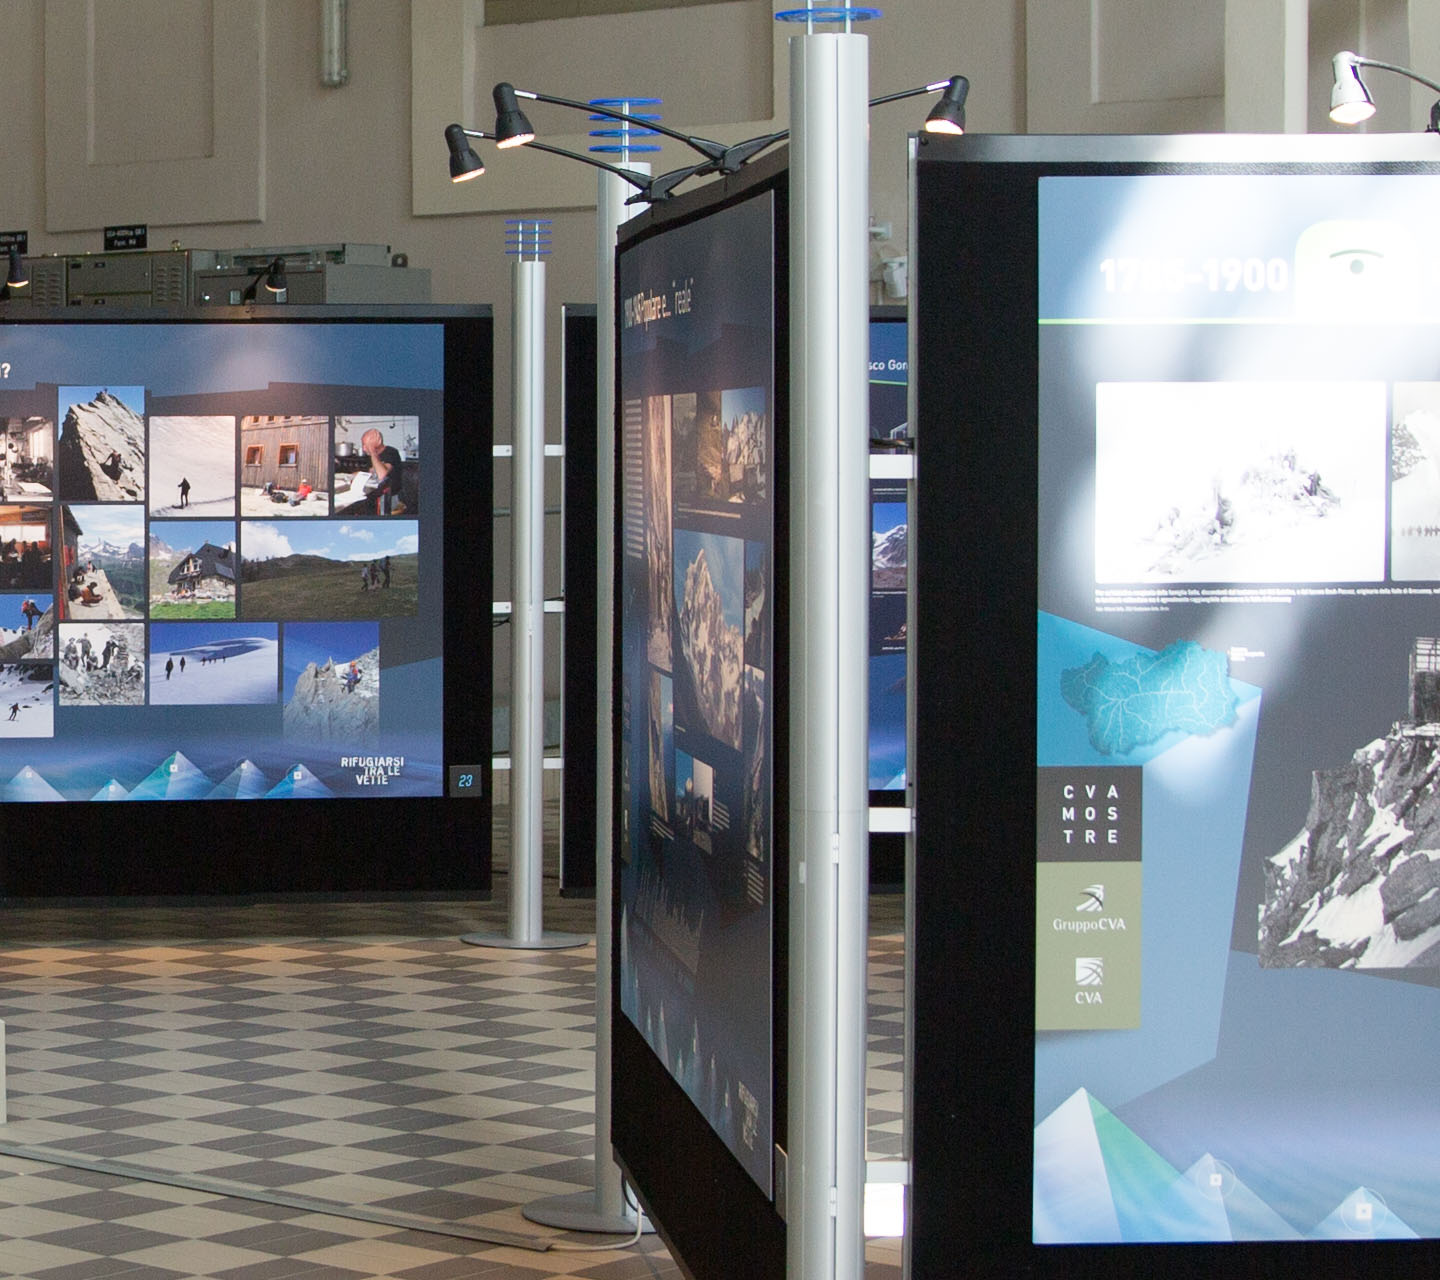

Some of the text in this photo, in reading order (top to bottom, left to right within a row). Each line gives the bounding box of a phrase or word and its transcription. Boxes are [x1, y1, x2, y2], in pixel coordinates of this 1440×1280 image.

[340, 756, 405, 768] RIFUGIARSI
[364, 766, 401, 776] TRA LE
[355, 774, 389, 786] VETTE
[458, 774, 473, 788] 23
[1052, 917, 1126, 933] GruppoCVA
[1074, 991, 1104, 1004] CVA
